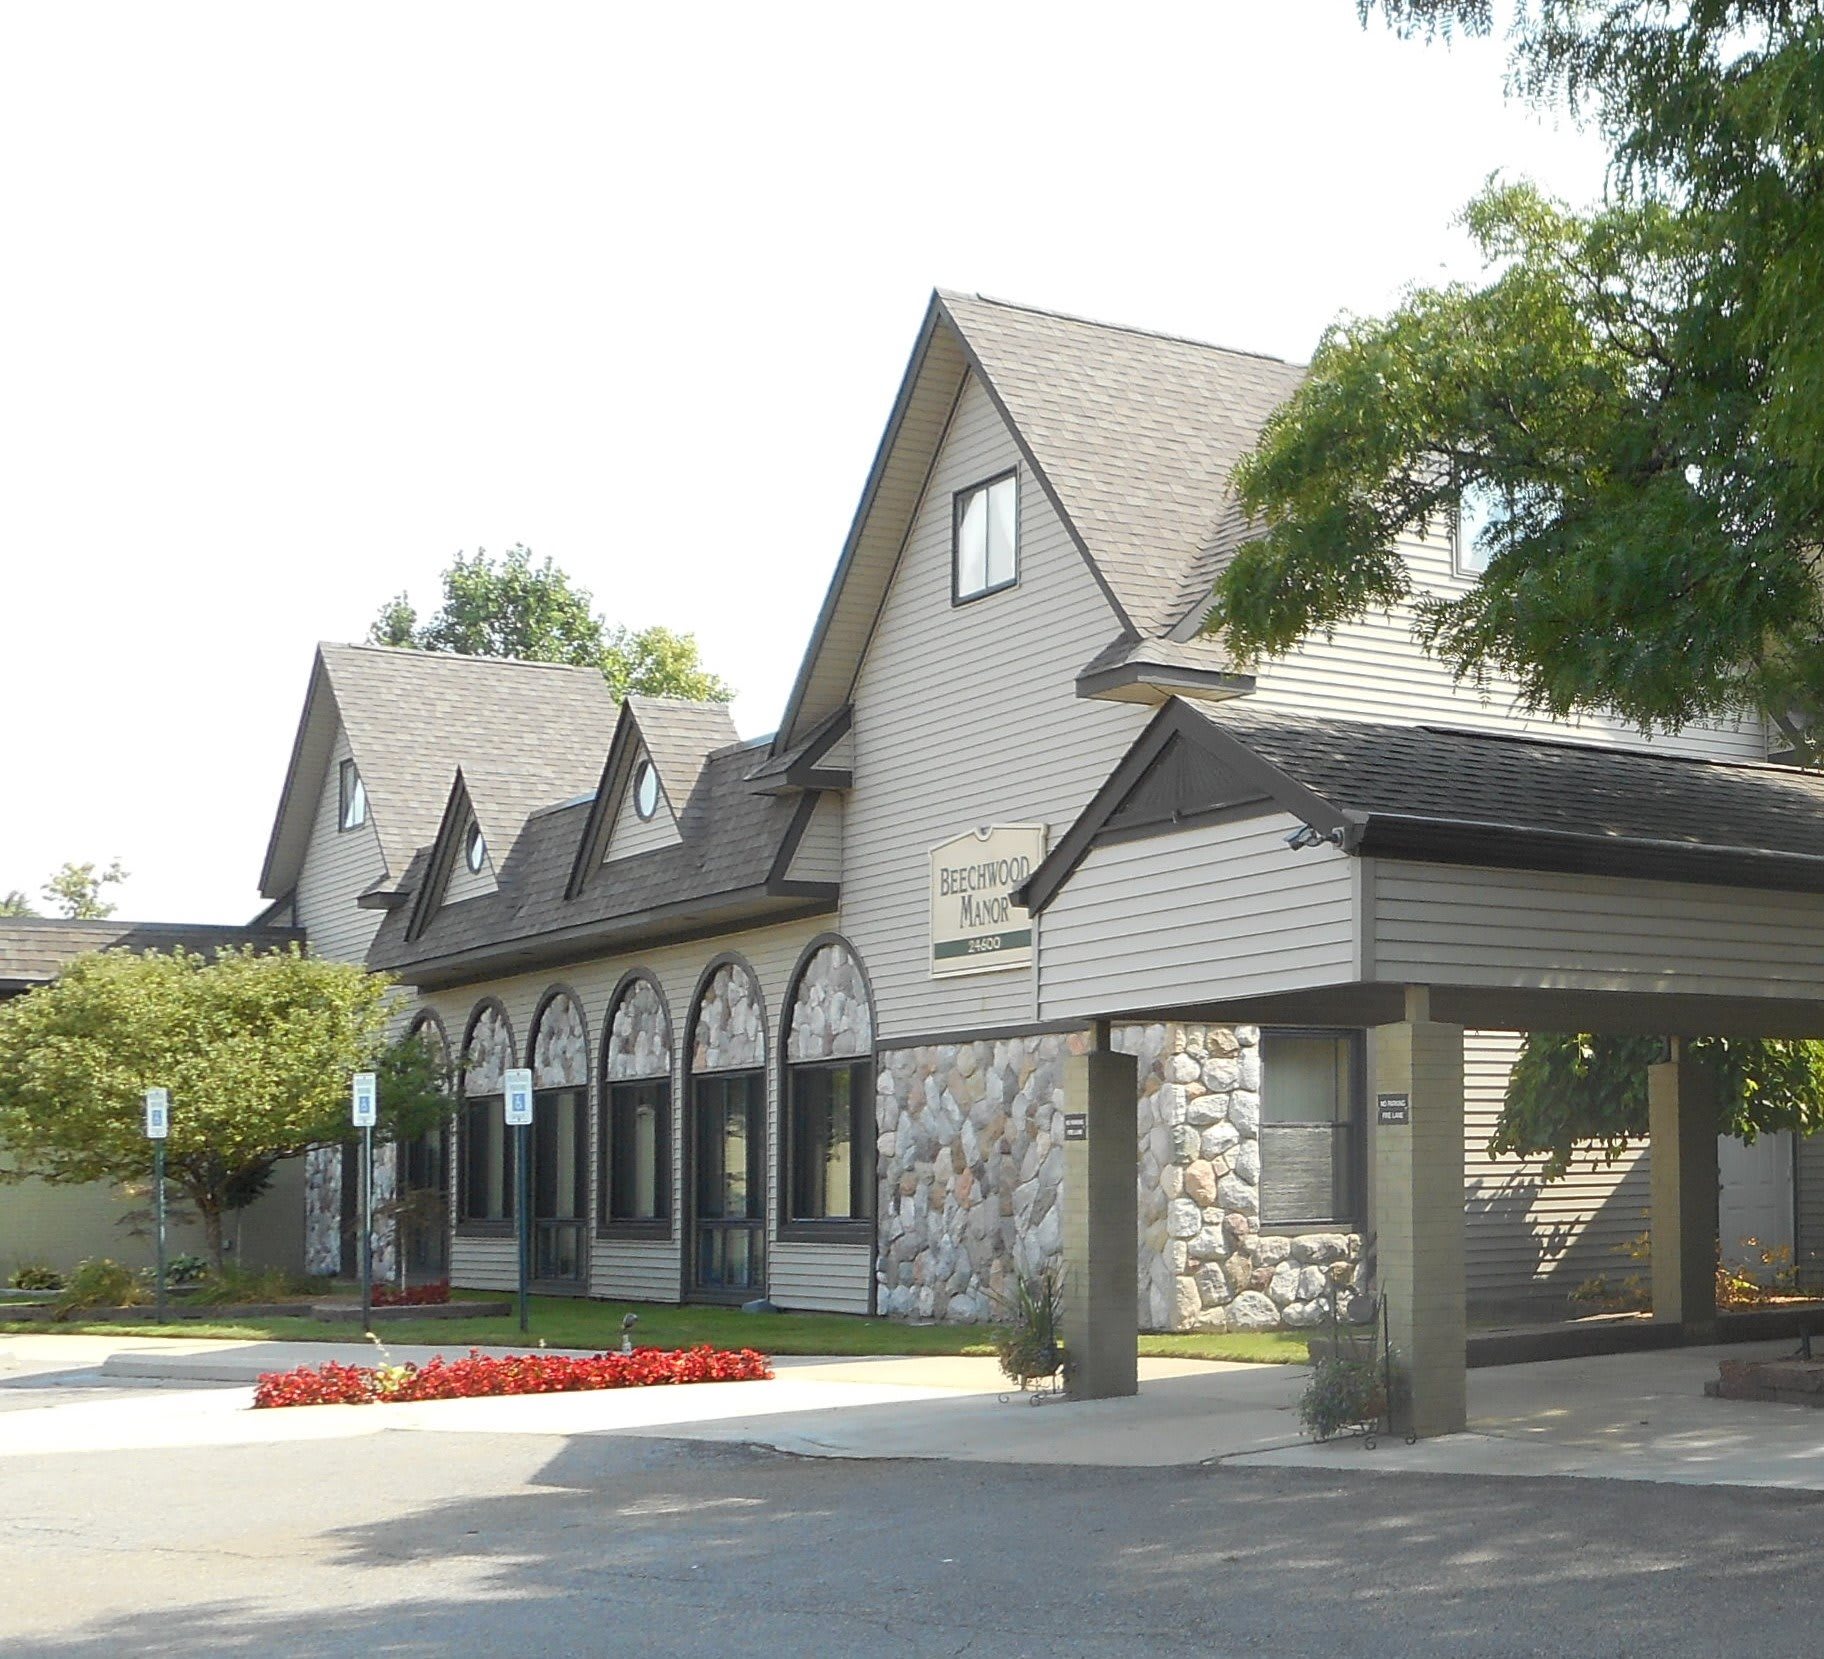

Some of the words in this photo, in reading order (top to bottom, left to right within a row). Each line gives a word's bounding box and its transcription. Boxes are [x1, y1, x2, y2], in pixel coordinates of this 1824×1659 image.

[940, 856, 1030, 896] BEECHWOOD
[960, 895, 1009, 929] MANOR
[968, 936, 1001, 953] 24600
